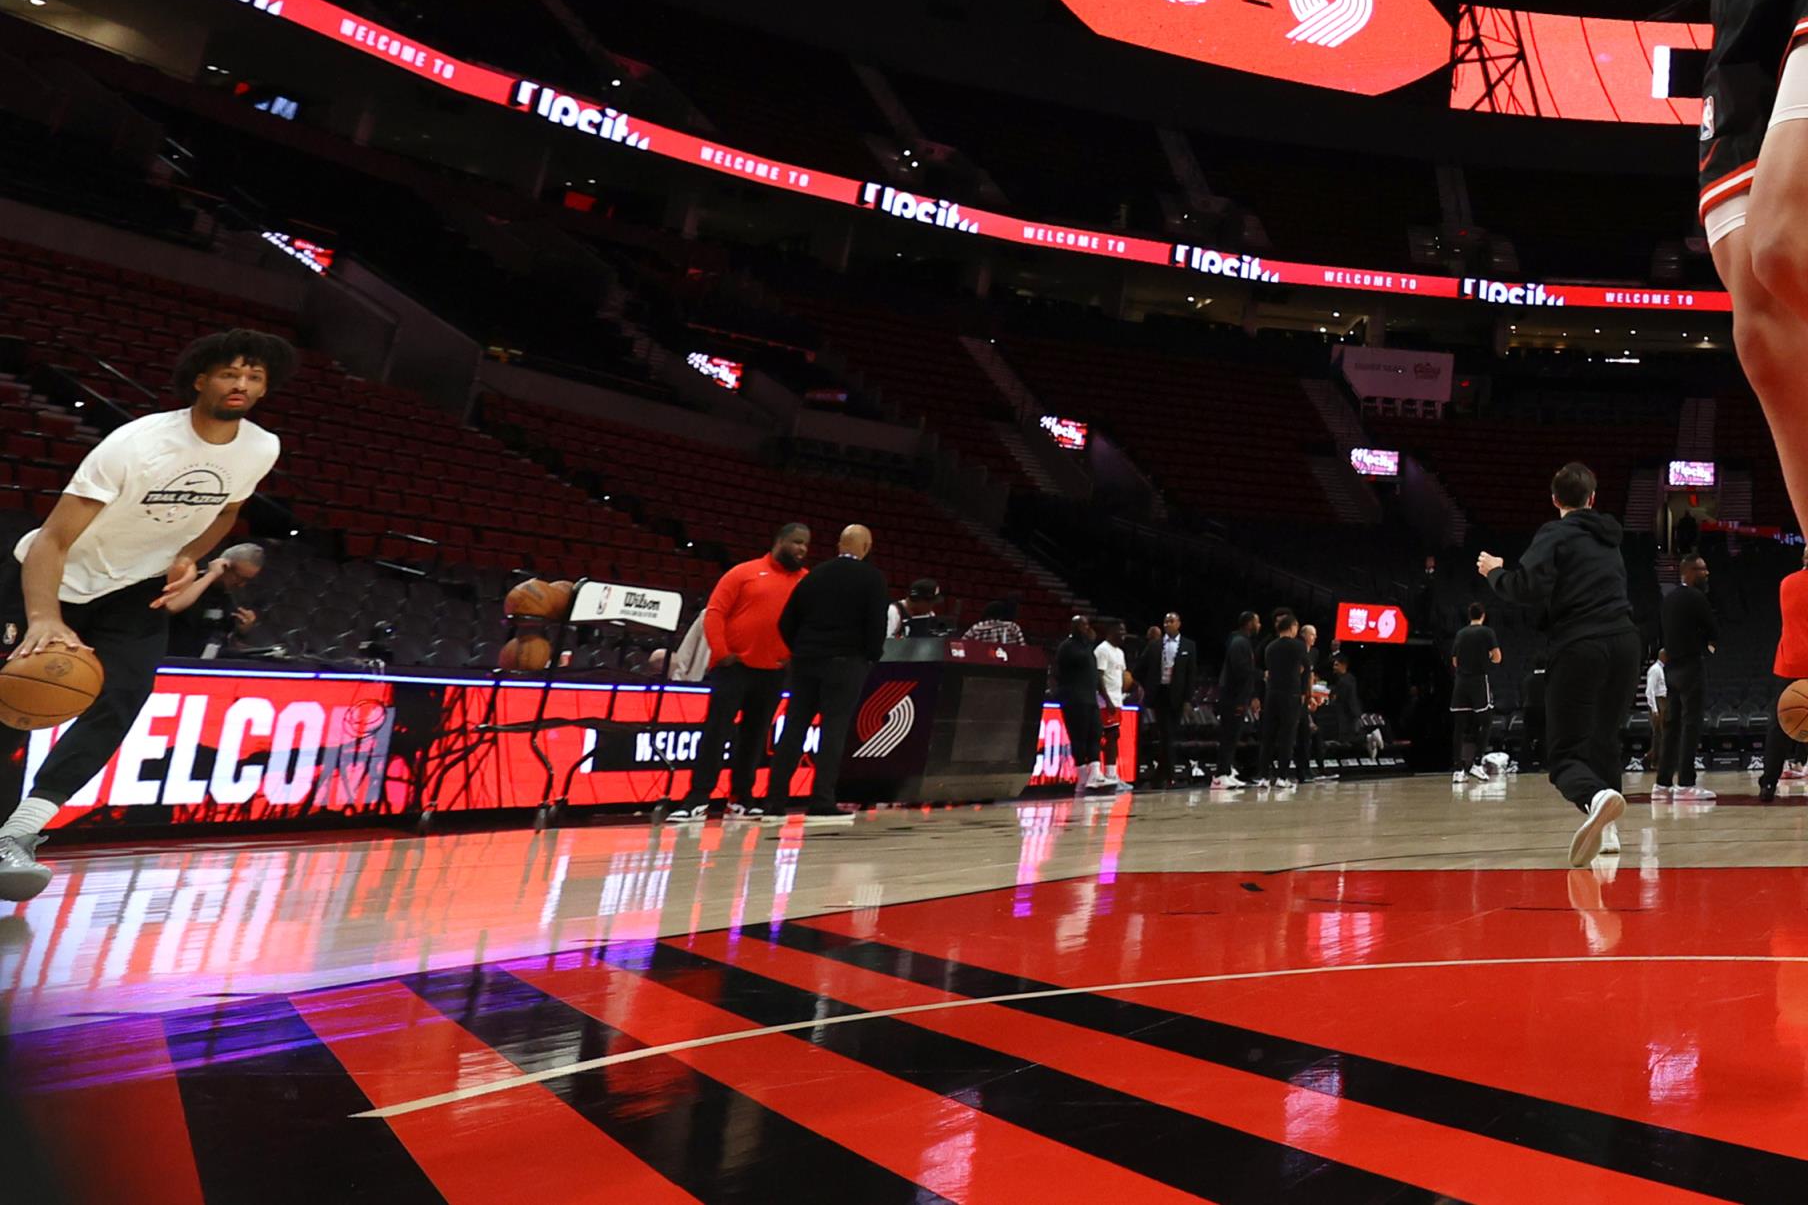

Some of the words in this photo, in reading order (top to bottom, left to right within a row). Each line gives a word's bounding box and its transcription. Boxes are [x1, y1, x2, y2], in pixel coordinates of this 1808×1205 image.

[340, 18, 427, 68] WELCOME
[433, 58, 455, 80] TO
[700, 145, 780, 181] WELCOME
[787, 170, 810, 188] TO
[1022, 225, 1100, 249] WELCOME
[1107, 239, 1126, 254] TO
[1323, 270, 1393, 288] WELCOME
[1399, 278, 1417, 290] TO
[1605, 291, 1671, 306] WELCOME
[1677, 294, 1694, 306] TO
[623, 591, 661, 611] Wilson
